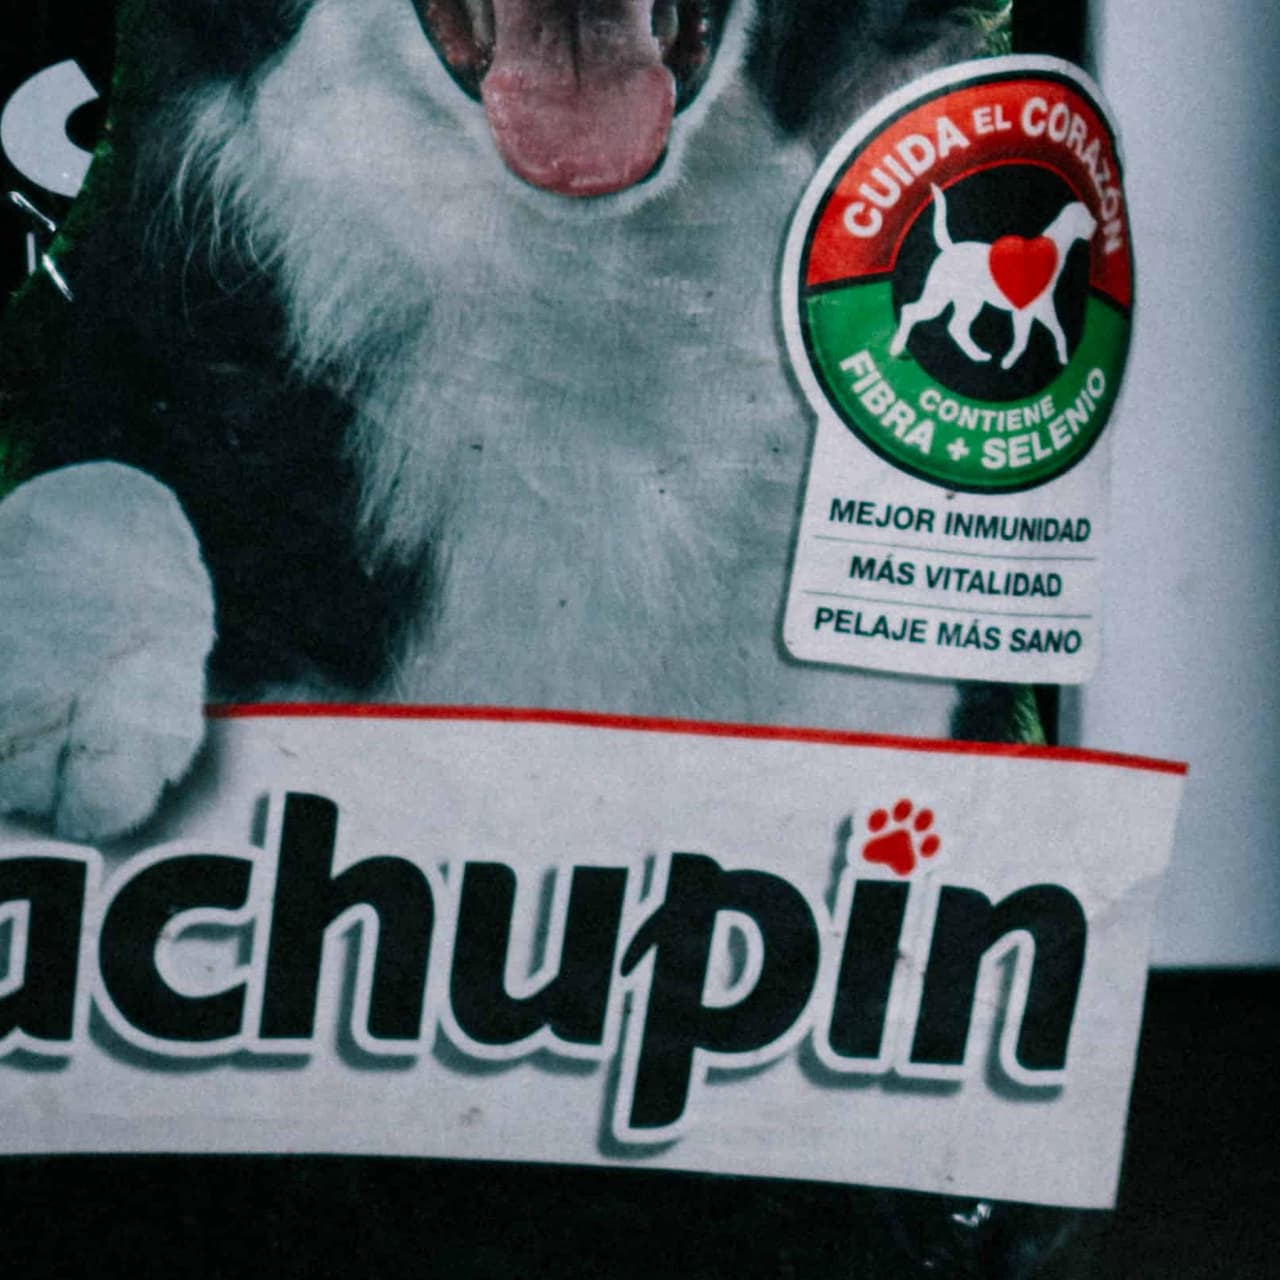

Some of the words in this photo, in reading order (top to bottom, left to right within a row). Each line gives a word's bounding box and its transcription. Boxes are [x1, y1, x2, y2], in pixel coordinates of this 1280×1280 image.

[843, 116, 970, 238] CUIDA
[972, 104, 1012, 135] EL
[840, 350, 936, 454] FIBRA
[981, 367, 1106, 470] SELENIO
[919, 389, 1056, 432] CONTIENE
[829, 498, 935, 533] MEJOR
[944, 511, 1091, 543] INMUNIDAD
[849, 553, 916, 586] MÁS
[925, 565, 1062, 598] VITALIDAD
[814, 607, 928, 644] PELAJE
[937, 619, 1001, 651] MÁS
[1009, 628, 1082, 655] SANO
